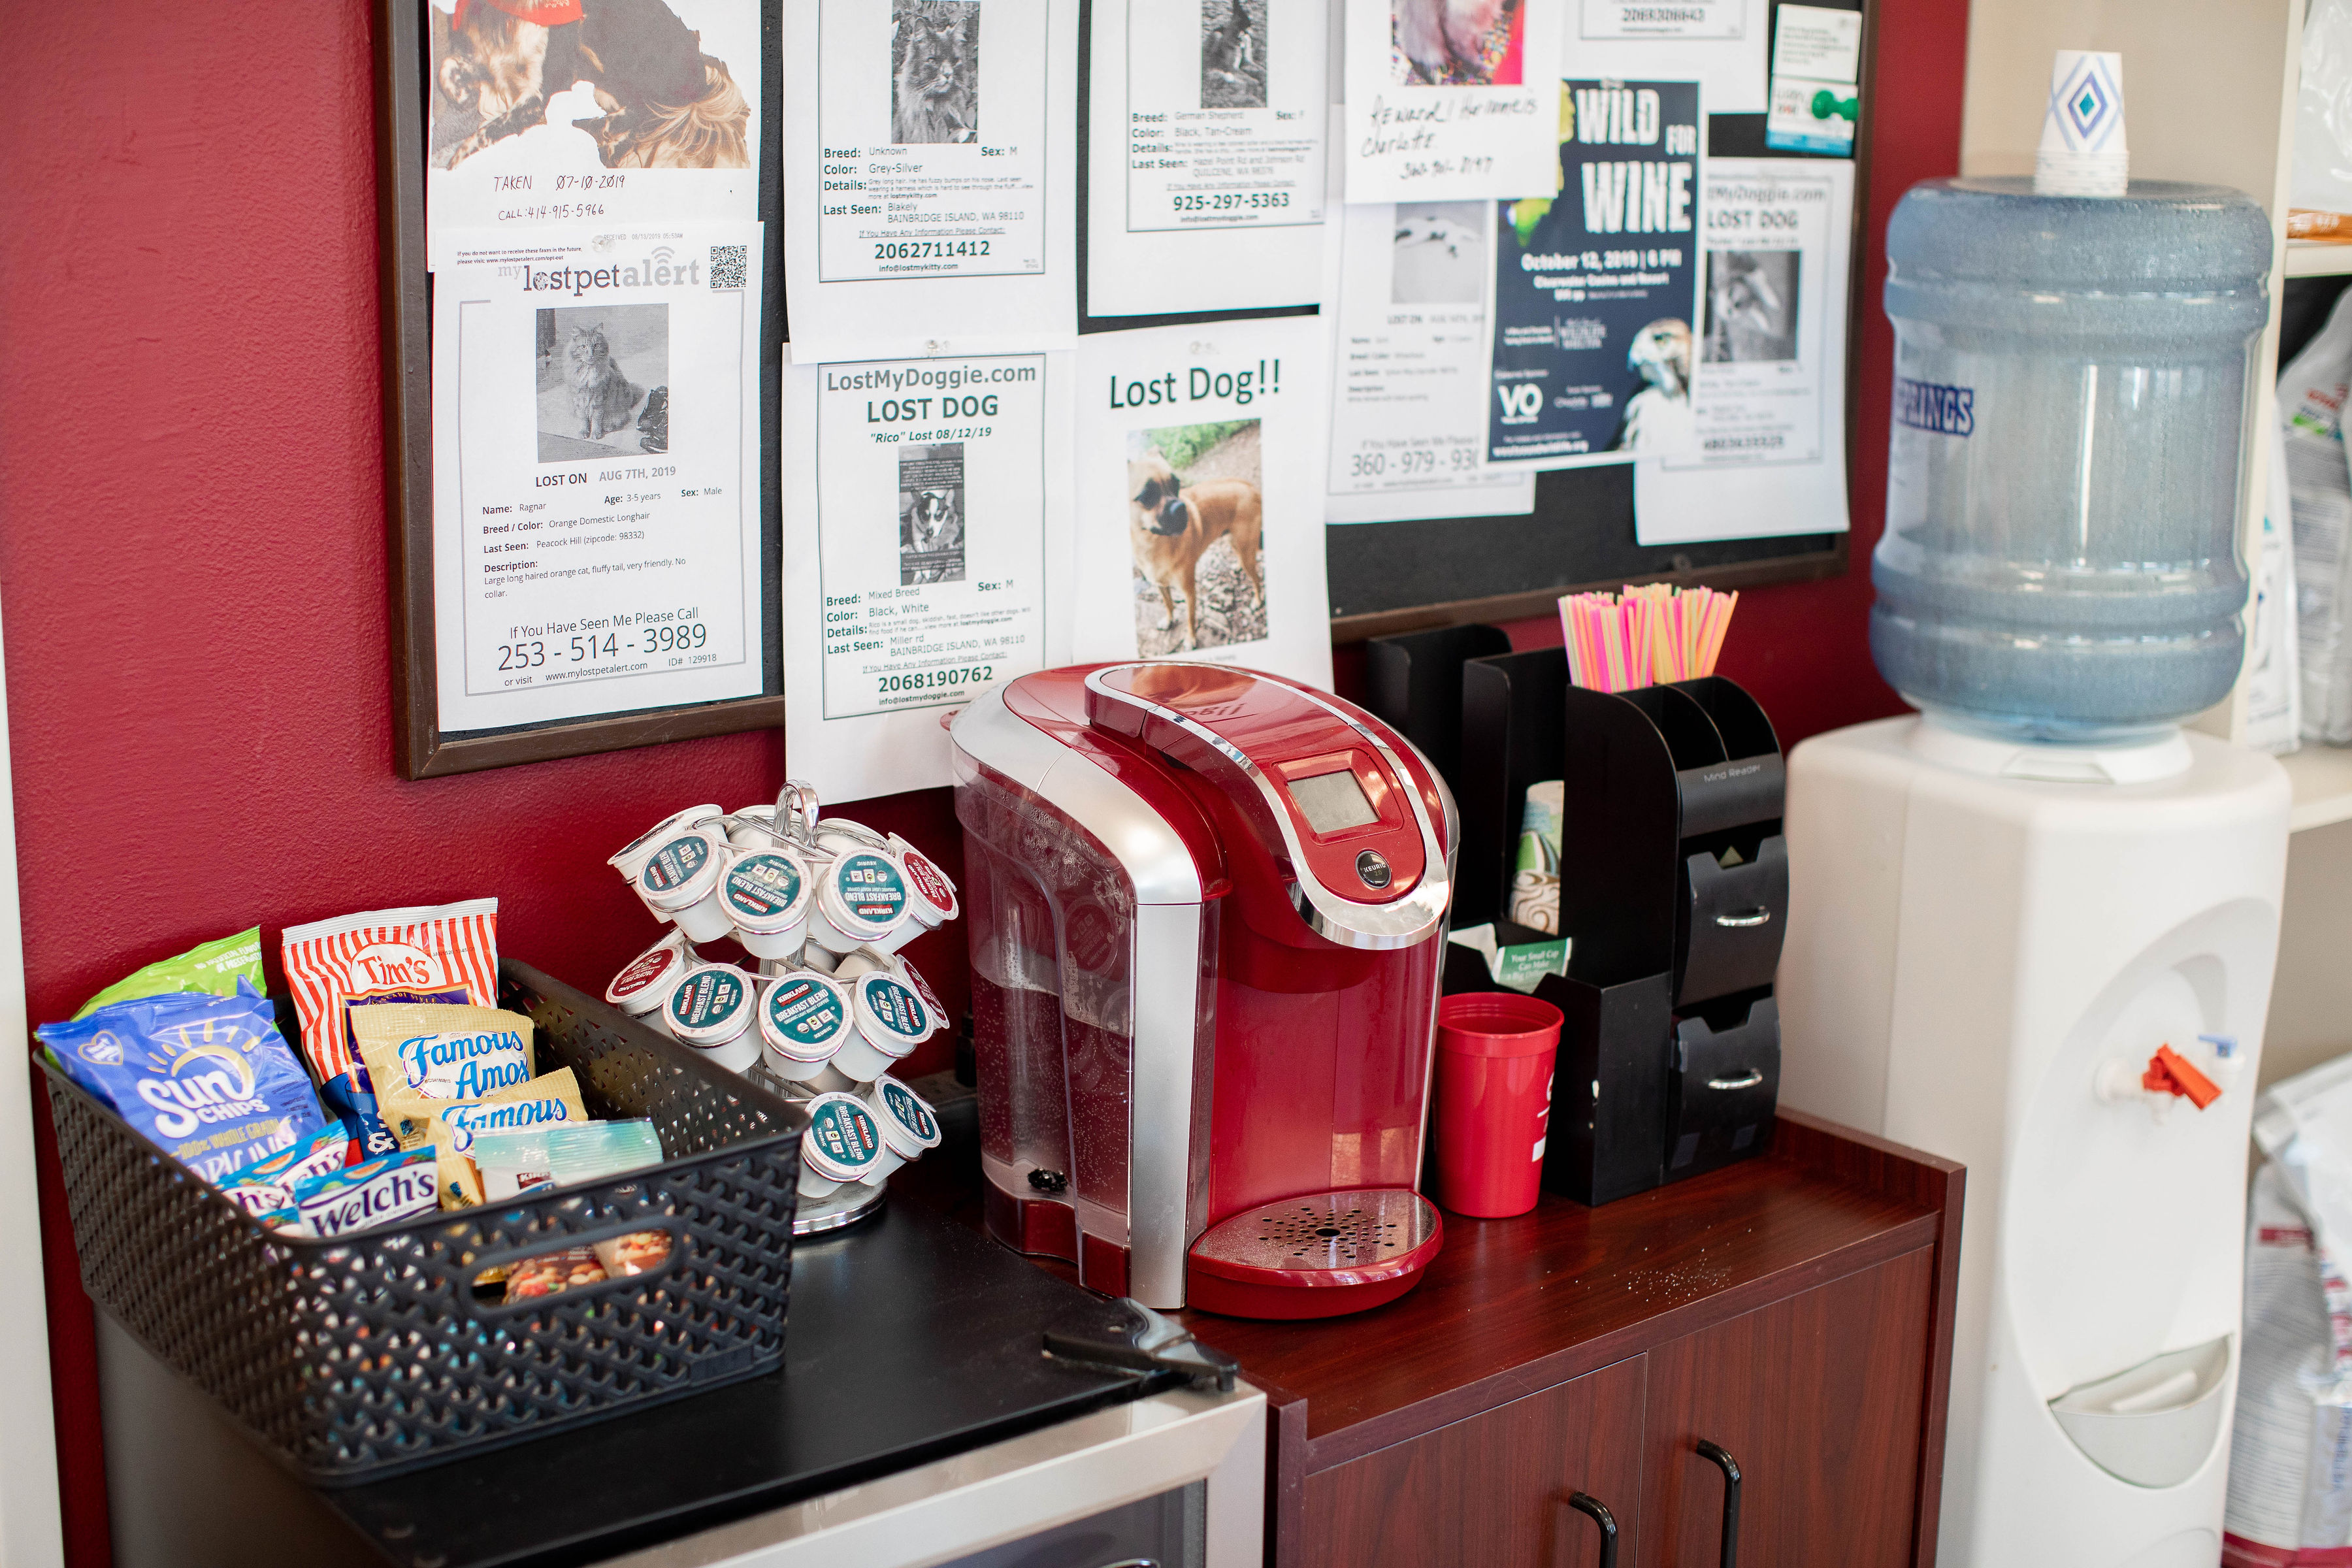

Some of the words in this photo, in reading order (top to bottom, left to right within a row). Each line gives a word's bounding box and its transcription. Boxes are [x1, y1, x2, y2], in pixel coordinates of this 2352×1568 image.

[1132, 112, 1168, 122] Breed:
[1575, 88, 1660, 146] WILD
[1132, 128, 1164, 138] Color:
[1665, 124, 1696, 155] FOR
[825, 149, 861, 157] Breed:
[869, 147, 907, 155] Unknown
[981, 147, 1005, 155] Sex:
[1132, 144, 1173, 153] Details:
[825, 165, 857, 174] Color:
[868, 163, 923, 175] Grey-Silver
[1132, 159, 1154, 169] Last
[1158, 159, 1188, 168] Seen:
[494, 175, 532, 191] TAKEN
[825, 181, 867, 190] Details:
[1173, 193, 1290, 211] 925-297-5363
[1581, 161, 1692, 233] WINE
[824, 205, 847, 214] Last
[851, 204, 881, 214] Seen:
[888, 203, 917, 213] Blakely
[888, 213, 941, 223] BAINBRIDGE
[945, 212, 979, 222] ISLAND,
[982, 212, 996, 221] WA
[1708, 210, 1752, 229] LOST
[1761, 210, 1799, 229] DOG
[875, 240, 990, 259] 2062711412
[879, 262, 958, 272] info@lostmykitty.com
[1521, 252, 1579, 272] October
[828, 365, 1036, 391] LostMyDoggie.com
[1111, 372, 1176, 409] Lost
[1190, 358, 1279, 404] Dog!!
[868, 399, 932, 423] LOST
[943, 395, 998, 418] DOG
[871, 432, 906, 443] "Rico"
[909, 431, 932, 441] Lost
[937, 427, 992, 439] 08/12/19
[536, 475, 564, 487] LOST
[568, 473, 587, 485] ON
[599, 470, 622, 482] AUG
[625, 468, 648, 480] 7TH,
[652, 466, 676, 478] 2019
[483, 505, 512, 515] Name:
[519, 502, 546, 514] Ragnar
[604, 494, 623, 506] Age:
[627, 493, 638, 502] 3-5
[640, 491, 661, 502] years
[681, 488, 698, 497] Sex:
[704, 486, 722, 496] Male
[483, 524, 509, 534] Breed
[517, 520, 543, 531] Color:
[549, 518, 578, 529] Orange
[580, 514, 615, 526] Domestic
[617, 512, 650, 525] Longhair
[483, 544, 502, 553] Last
[504, 542, 529, 552] Seen:
[536, 537, 568, 549] Peacock
[570, 536, 582, 546] Hill
[584, 533, 617, 546] (zipcode:
[619, 531, 645, 542] 98332)
[484, 559, 538, 574] Description:
[826, 595, 860, 606] Breed:
[869, 589, 892, 600] Mixed
[895, 587, 920, 598] Breed
[978, 581, 1001, 591] Sex:
[826, 611, 858, 622] Color:
[869, 606, 898, 618] Black,
[902, 603, 929, 613] White
[510, 627, 517, 639] If
[521, 625, 544, 638] You
[547, 622, 577, 635] Have
[580, 617, 609, 630] Seen
[613, 615, 632, 627] Me
[635, 612, 674, 625] Please
[678, 607, 698, 621] Call
[827, 625, 868, 638] Details:
[498, 642, 546, 671] 253
[571, 632, 619, 662] 514
[644, 623, 707, 653] 3989
[828, 643, 851, 654] Last
[854, 640, 883, 651] Seen:
[504, 678, 514, 687] or
[516, 676, 532, 685] visit
[546, 661, 647, 681] www.mylostpetalert.com
[668, 657, 683, 667] ID#
[689, 653, 717, 664] 129918
[879, 666, 993, 693] 2068190762
[879, 689, 964, 706] info@lostmydoggie.com
[1704, 770, 1726, 783] Mind
[1729, 763, 1761, 779] Reader
[1364, 863, 1386, 873] KEURIG
[845, 892, 865, 902] BLEND
[866, 892, 902, 901] BREAKFAST
[357, 956, 430, 986] Tim's
[679, 985, 693, 1015] KIRKLAND
[690, 994, 707, 1024] BREAKFAST
[699, 975, 711, 993] BLEND
[777, 983, 809, 1003] KIRKLAND
[775, 1000, 809, 1022] BREAKFAST
[807, 989, 828, 1005] BLEND
[398, 1031, 523, 1089] Famous
[455, 1060, 531, 1100] Amos
[137, 1071, 256, 1138] Sun
[197, 1098, 270, 1124] CHIPS
[209, 1127, 247, 1149] WHOLE
[817, 1128, 827, 1147] KEURIG
[840, 1105, 857, 1140] BREAKFAST
[851, 1141, 864, 1160] BLEND
[858, 1115, 873, 1149] KIRKLAND
[308, 1171, 434, 1237] Welch's
